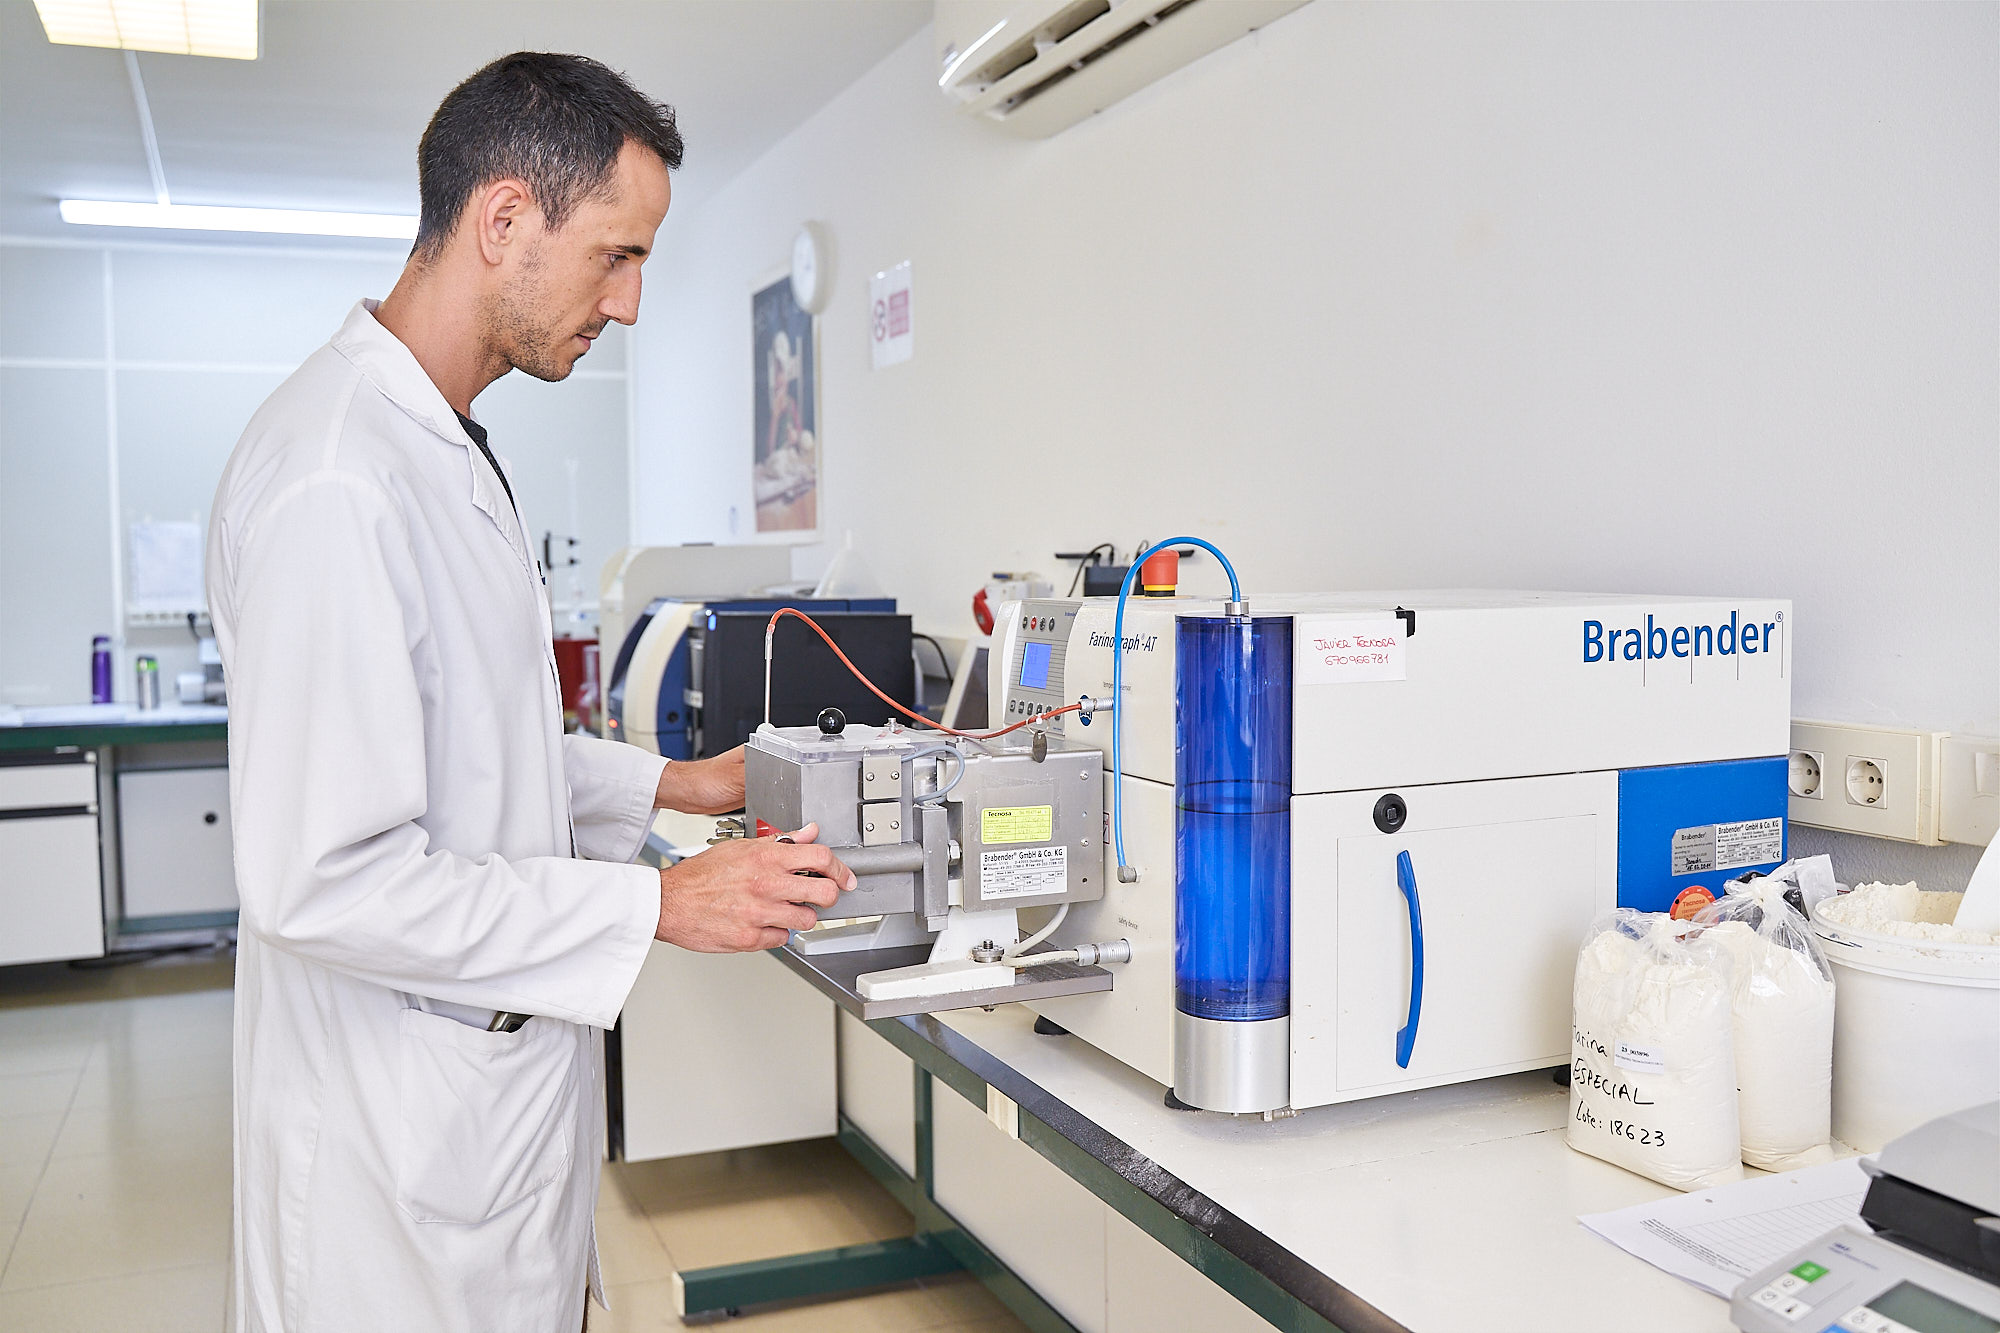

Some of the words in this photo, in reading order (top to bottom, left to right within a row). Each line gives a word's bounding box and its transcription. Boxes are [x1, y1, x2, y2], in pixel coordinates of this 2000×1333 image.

[1745, 822, 1759, 831] GmbH
[1772, 819, 1779, 828] KG
[1018, 850, 1037, 860] GmbH
[1037, 850, 1042, 858] &
[1043, 849, 1053, 858] Co.
[1054, 848, 1063, 857] KG
[1573, 1057, 1655, 1105] ESPECIAL
[1576, 1100, 1603, 1129] Lote:
[1610, 1120, 1666, 1148] 18623
